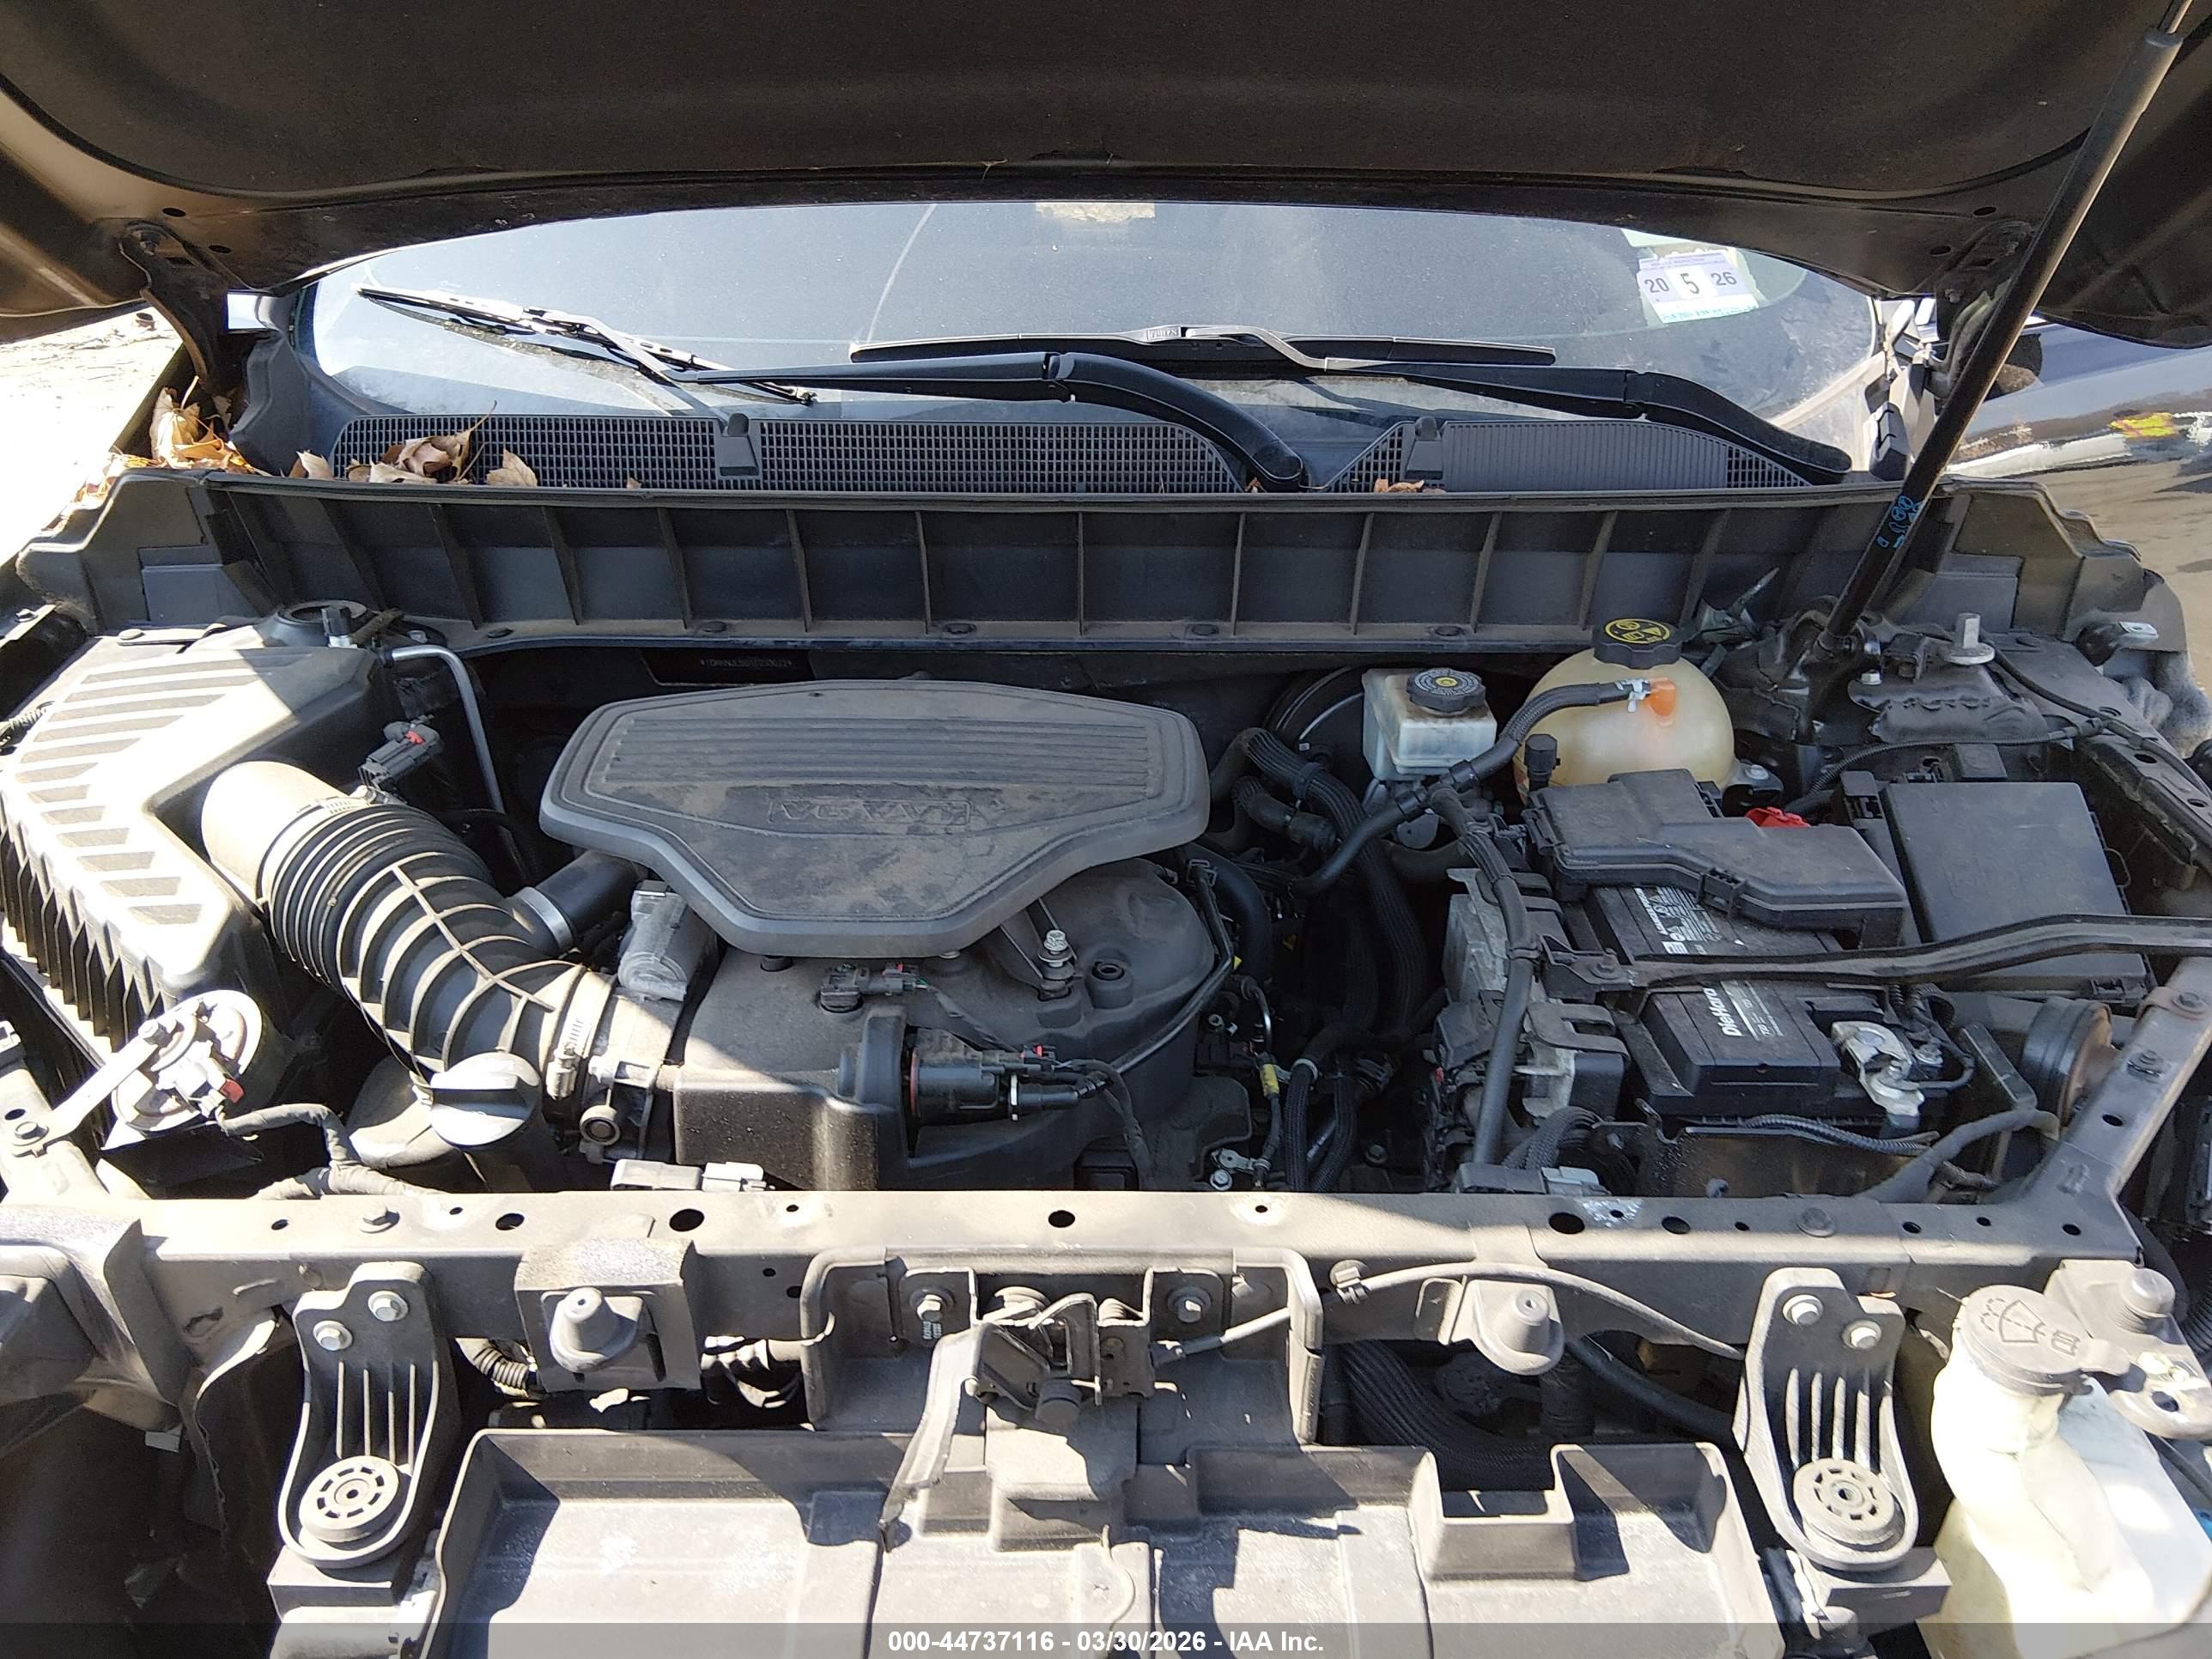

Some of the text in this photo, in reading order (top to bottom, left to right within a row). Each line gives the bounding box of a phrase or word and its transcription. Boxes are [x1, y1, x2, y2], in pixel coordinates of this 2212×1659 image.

[1644, 271, 1738, 295] 20 5 26
